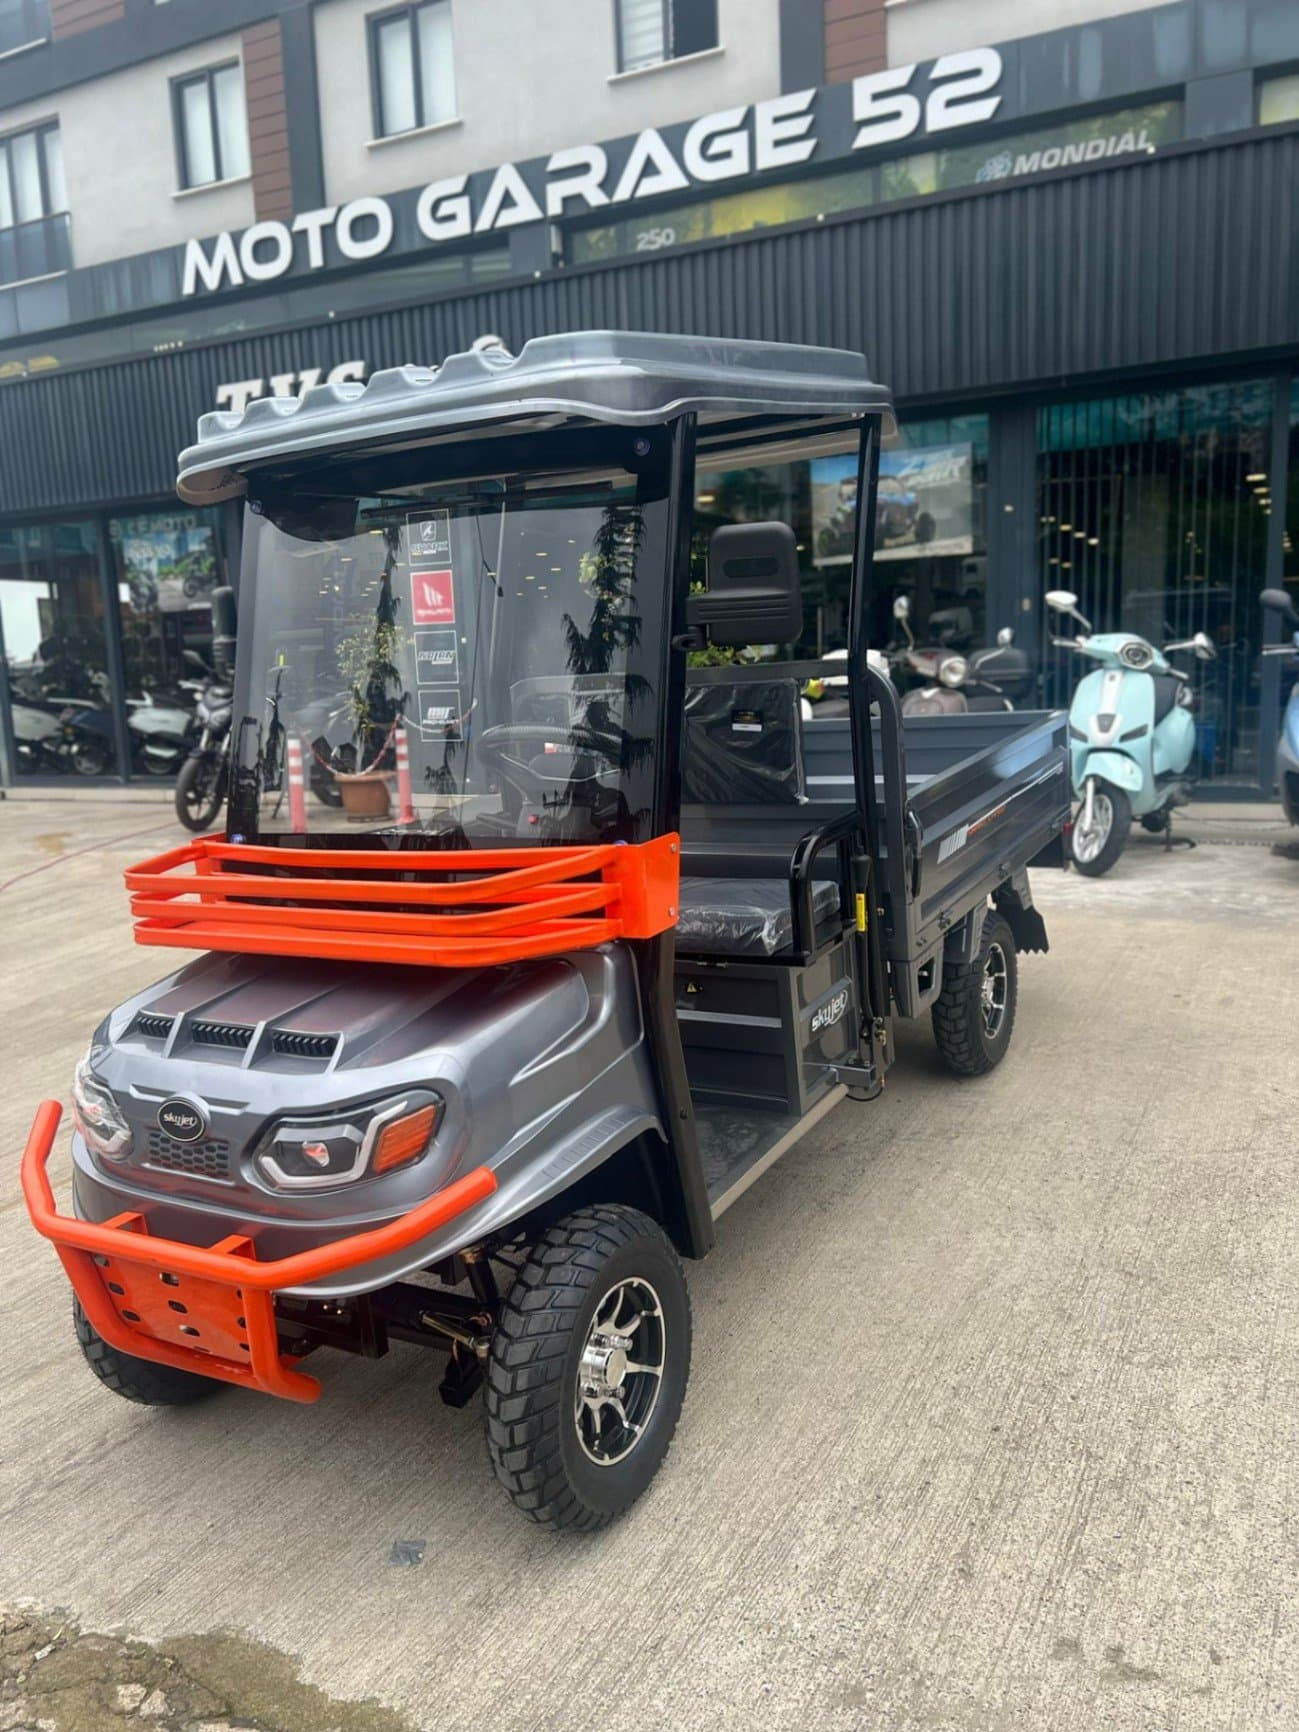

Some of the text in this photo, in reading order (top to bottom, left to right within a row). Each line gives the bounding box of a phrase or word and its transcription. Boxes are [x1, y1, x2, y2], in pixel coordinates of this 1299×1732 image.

[182, 47, 1002, 296] MOTO GARAGE 52
[1013, 130, 1153, 177] MONDIAL
[636, 227, 676, 251] 250
